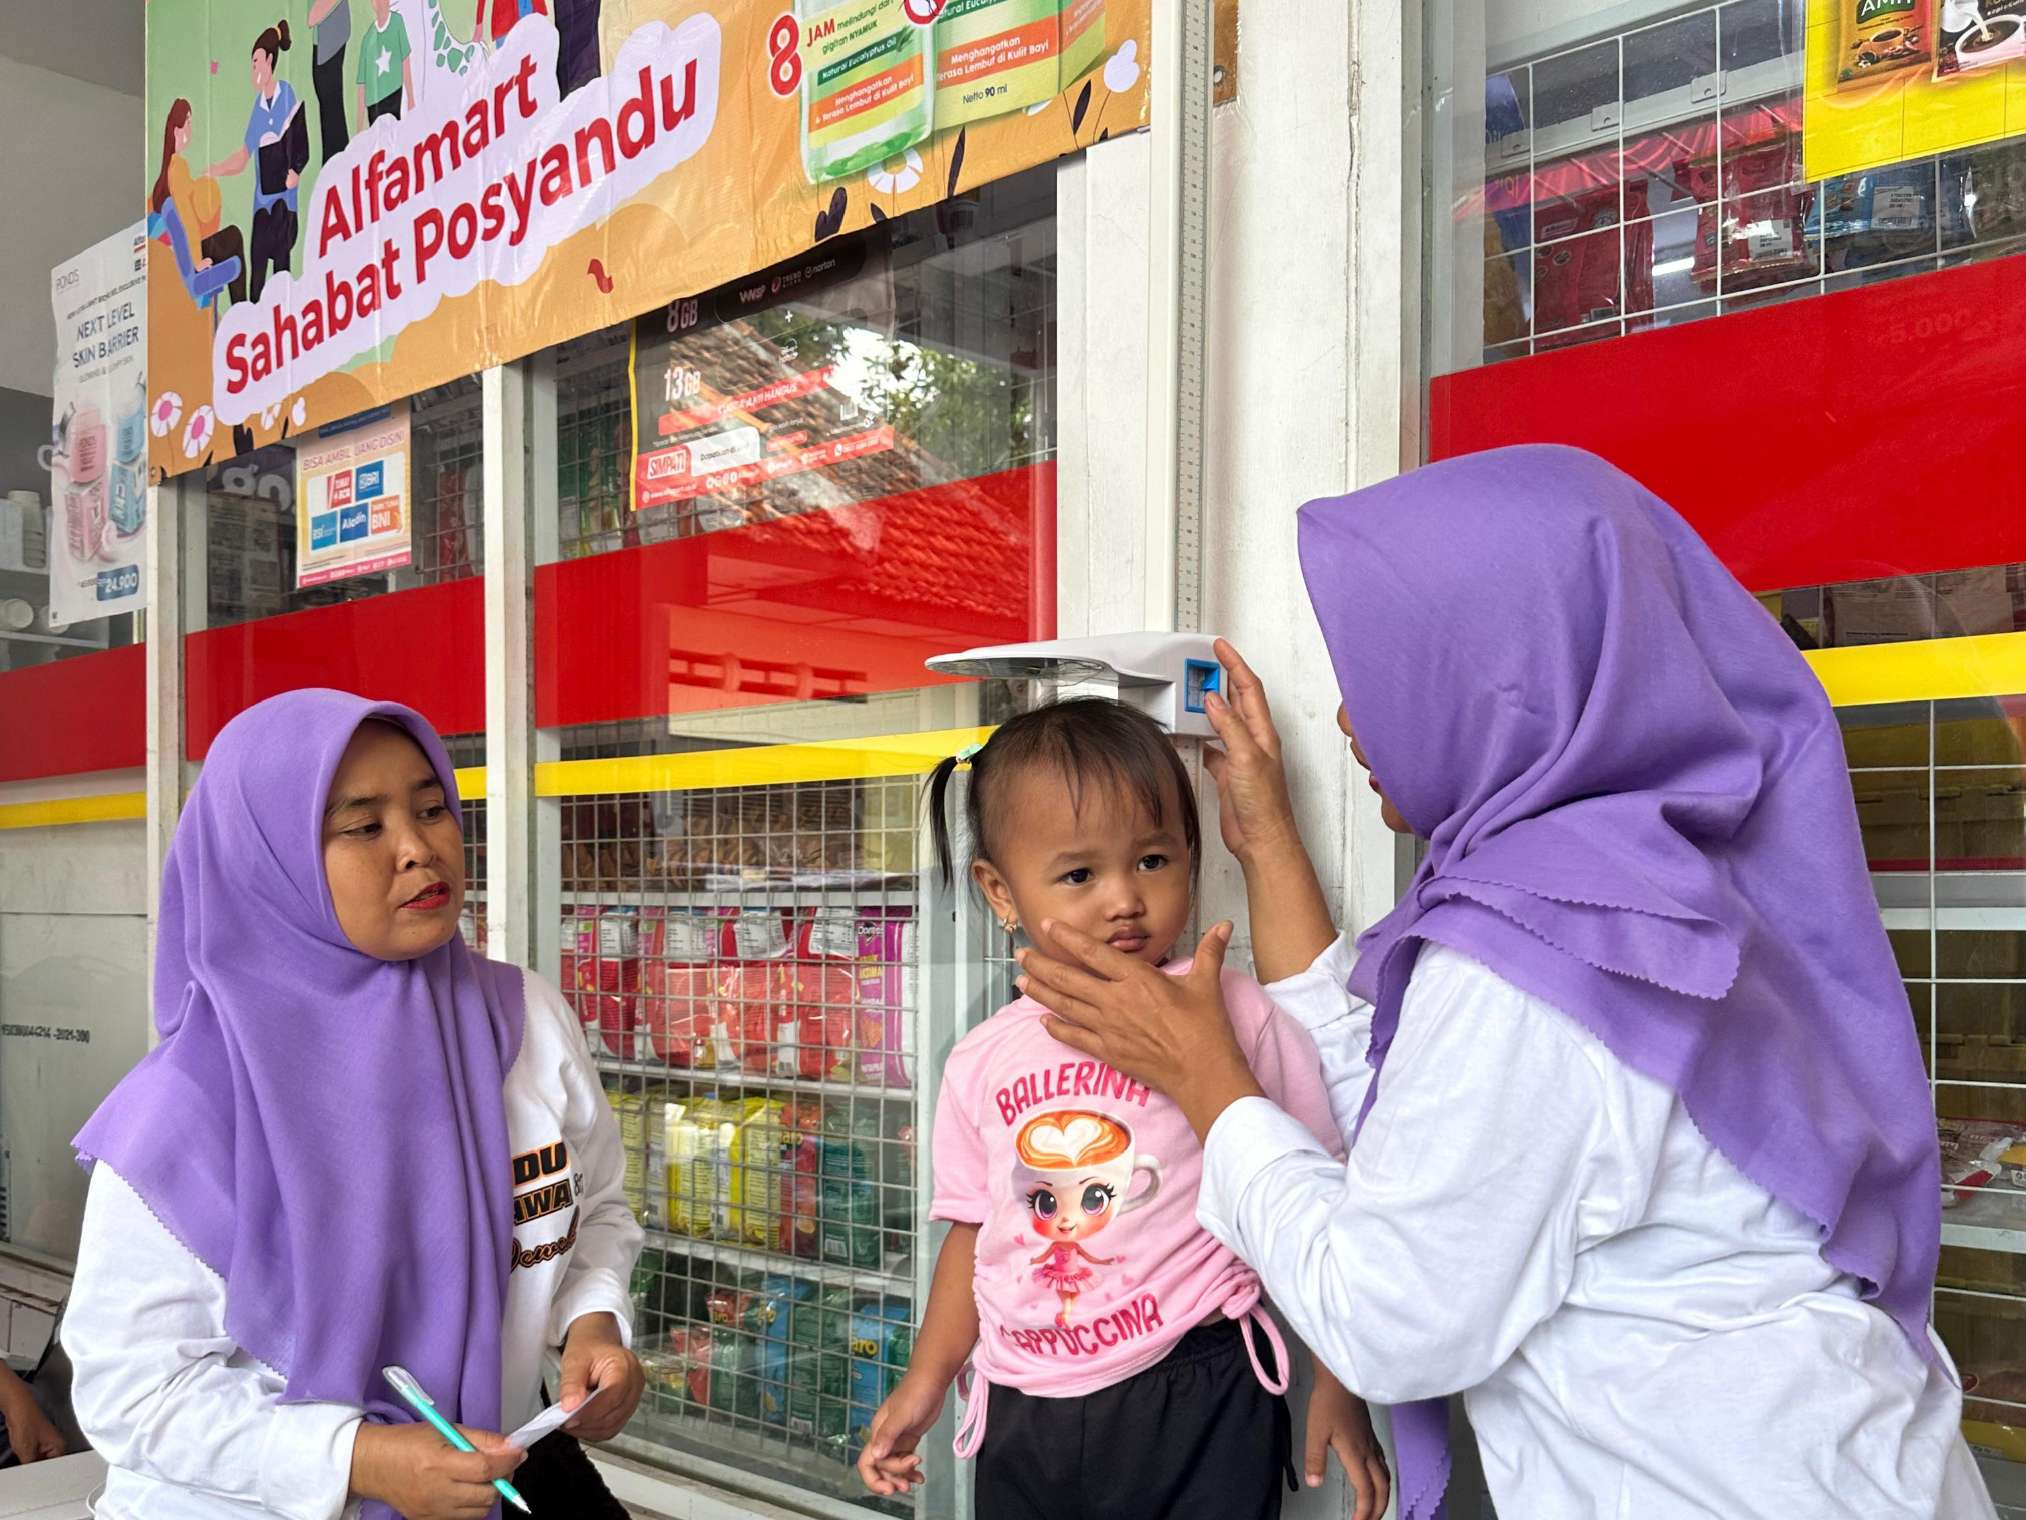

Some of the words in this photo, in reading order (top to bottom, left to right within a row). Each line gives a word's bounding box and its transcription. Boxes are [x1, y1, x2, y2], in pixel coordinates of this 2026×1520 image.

[769, 14, 802, 96] 8
[807, 19, 835, 47] JAM
[837, 5, 878, 30] melindungi
[822, 36, 849, 56] gigitan
[850, 20, 878, 40] NYAMUK
[951, 36, 1020, 64] Menghangatkan
[823, 63, 849, 79] Natural
[849, 43, 885, 68] Eucalyptus
[886, 36, 897, 48] Oil
[965, 57, 996, 75] Lembut
[997, 53, 1006, 64] di
[1007, 49, 1028, 62] Kulit
[1028, 40, 1049, 56] Bayi
[822, 108, 845, 122] Terasa
[846, 95, 872, 112] Lembut
[873, 92, 882, 102] di
[882, 83, 898, 98] Kulit
[899, 74, 914, 93] Bayi
[835, 75, 892, 105] Menghangatkan
[963, 91, 984, 104] Netto
[985, 86, 996, 98] 90
[997, 83, 1008, 95] ml
[319, 54, 537, 258] Alfamart
[226, 238, 402, 394] Sahabat
[413, 59, 698, 284] Posyandu
[812, 258, 836, 274] norton
[76, 315, 105, 342] NEXT
[107, 302, 135, 329] LEVEL
[72, 347, 96, 369] SKIN
[98, 326, 140, 359] BARRIER
[303, 456, 323, 471] BISA
[325, 447, 351, 465] AMBIL
[354, 438, 379, 457] UANG
[649, 450, 687, 478] SIMPATI
[342, 512, 367, 530] Aladin
[371, 510, 391, 529] BNI
[995, 1060, 1152, 1128] BALLERINA
[999, 1293, 1165, 1356] APPUCCINA
[850, 1335, 878, 1359] aro
